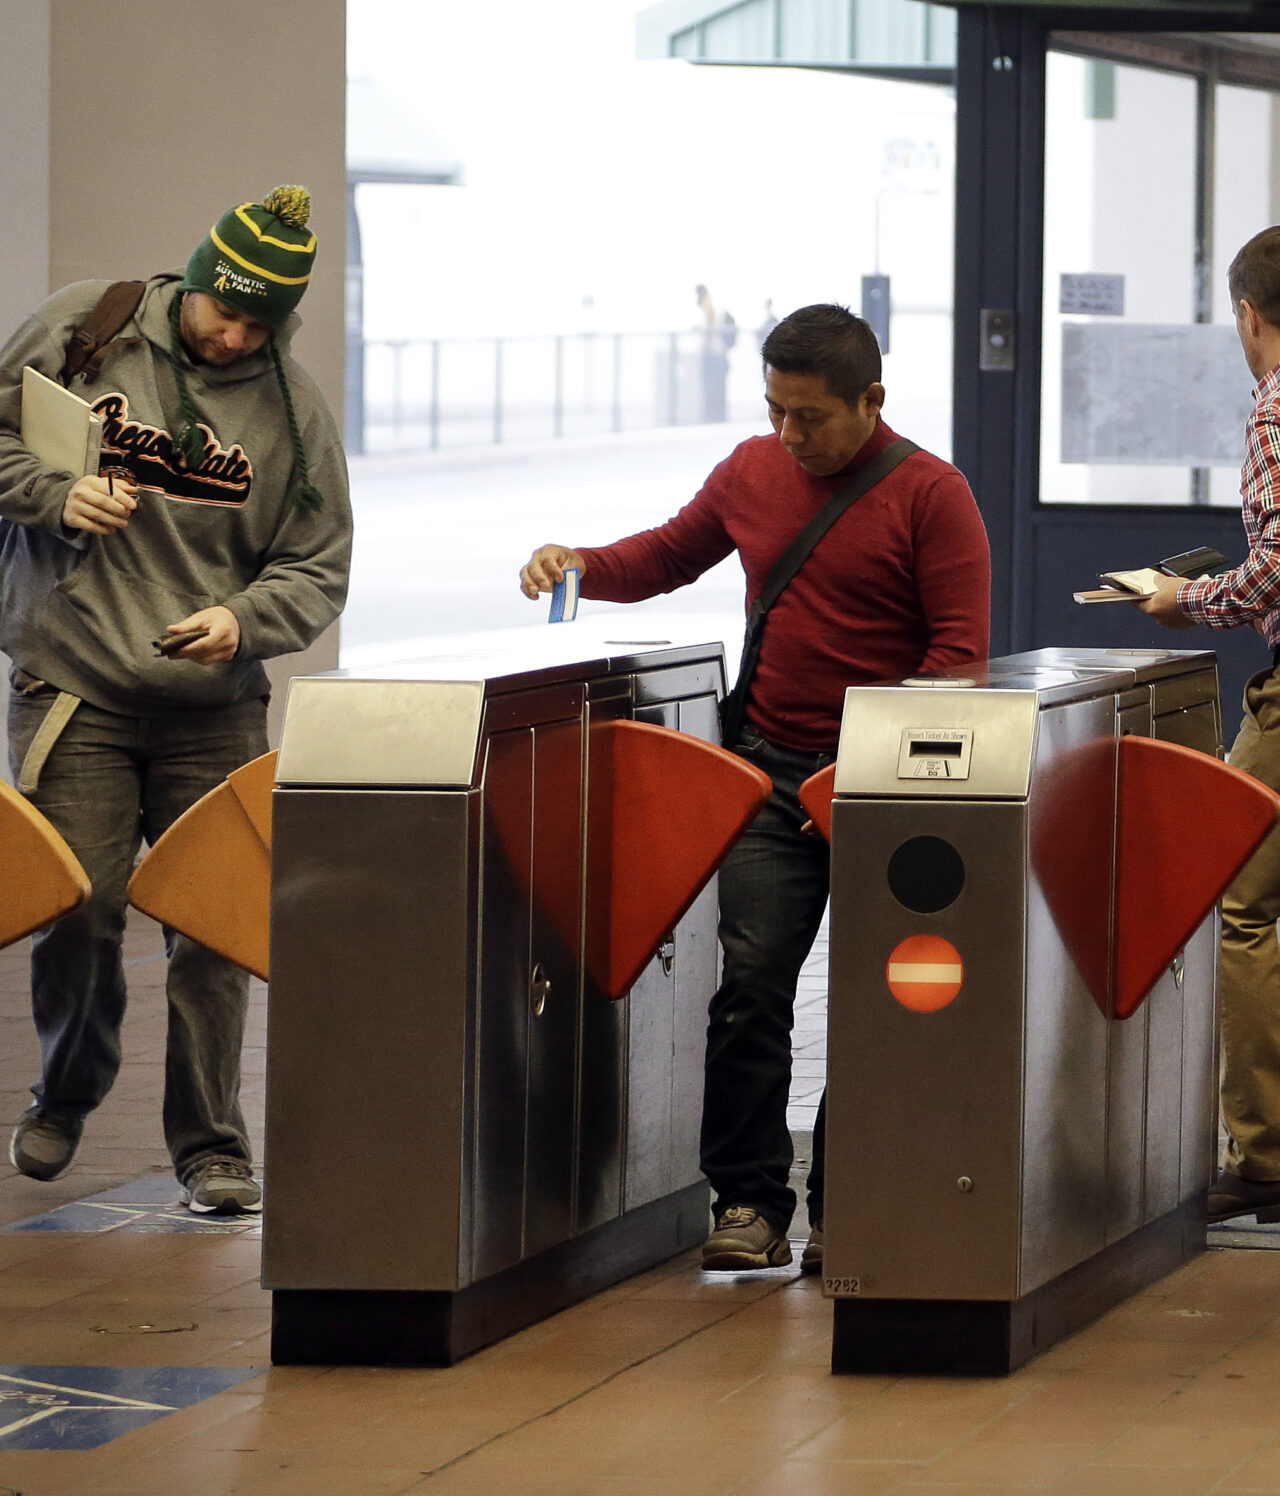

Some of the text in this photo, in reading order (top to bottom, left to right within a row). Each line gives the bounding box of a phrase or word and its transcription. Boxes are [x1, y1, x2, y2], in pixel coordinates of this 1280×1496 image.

[214, 264, 267, 289] AUTHENTIC
[231, 281, 252, 294] FAN
[926, 731, 941, 739] Ticket
